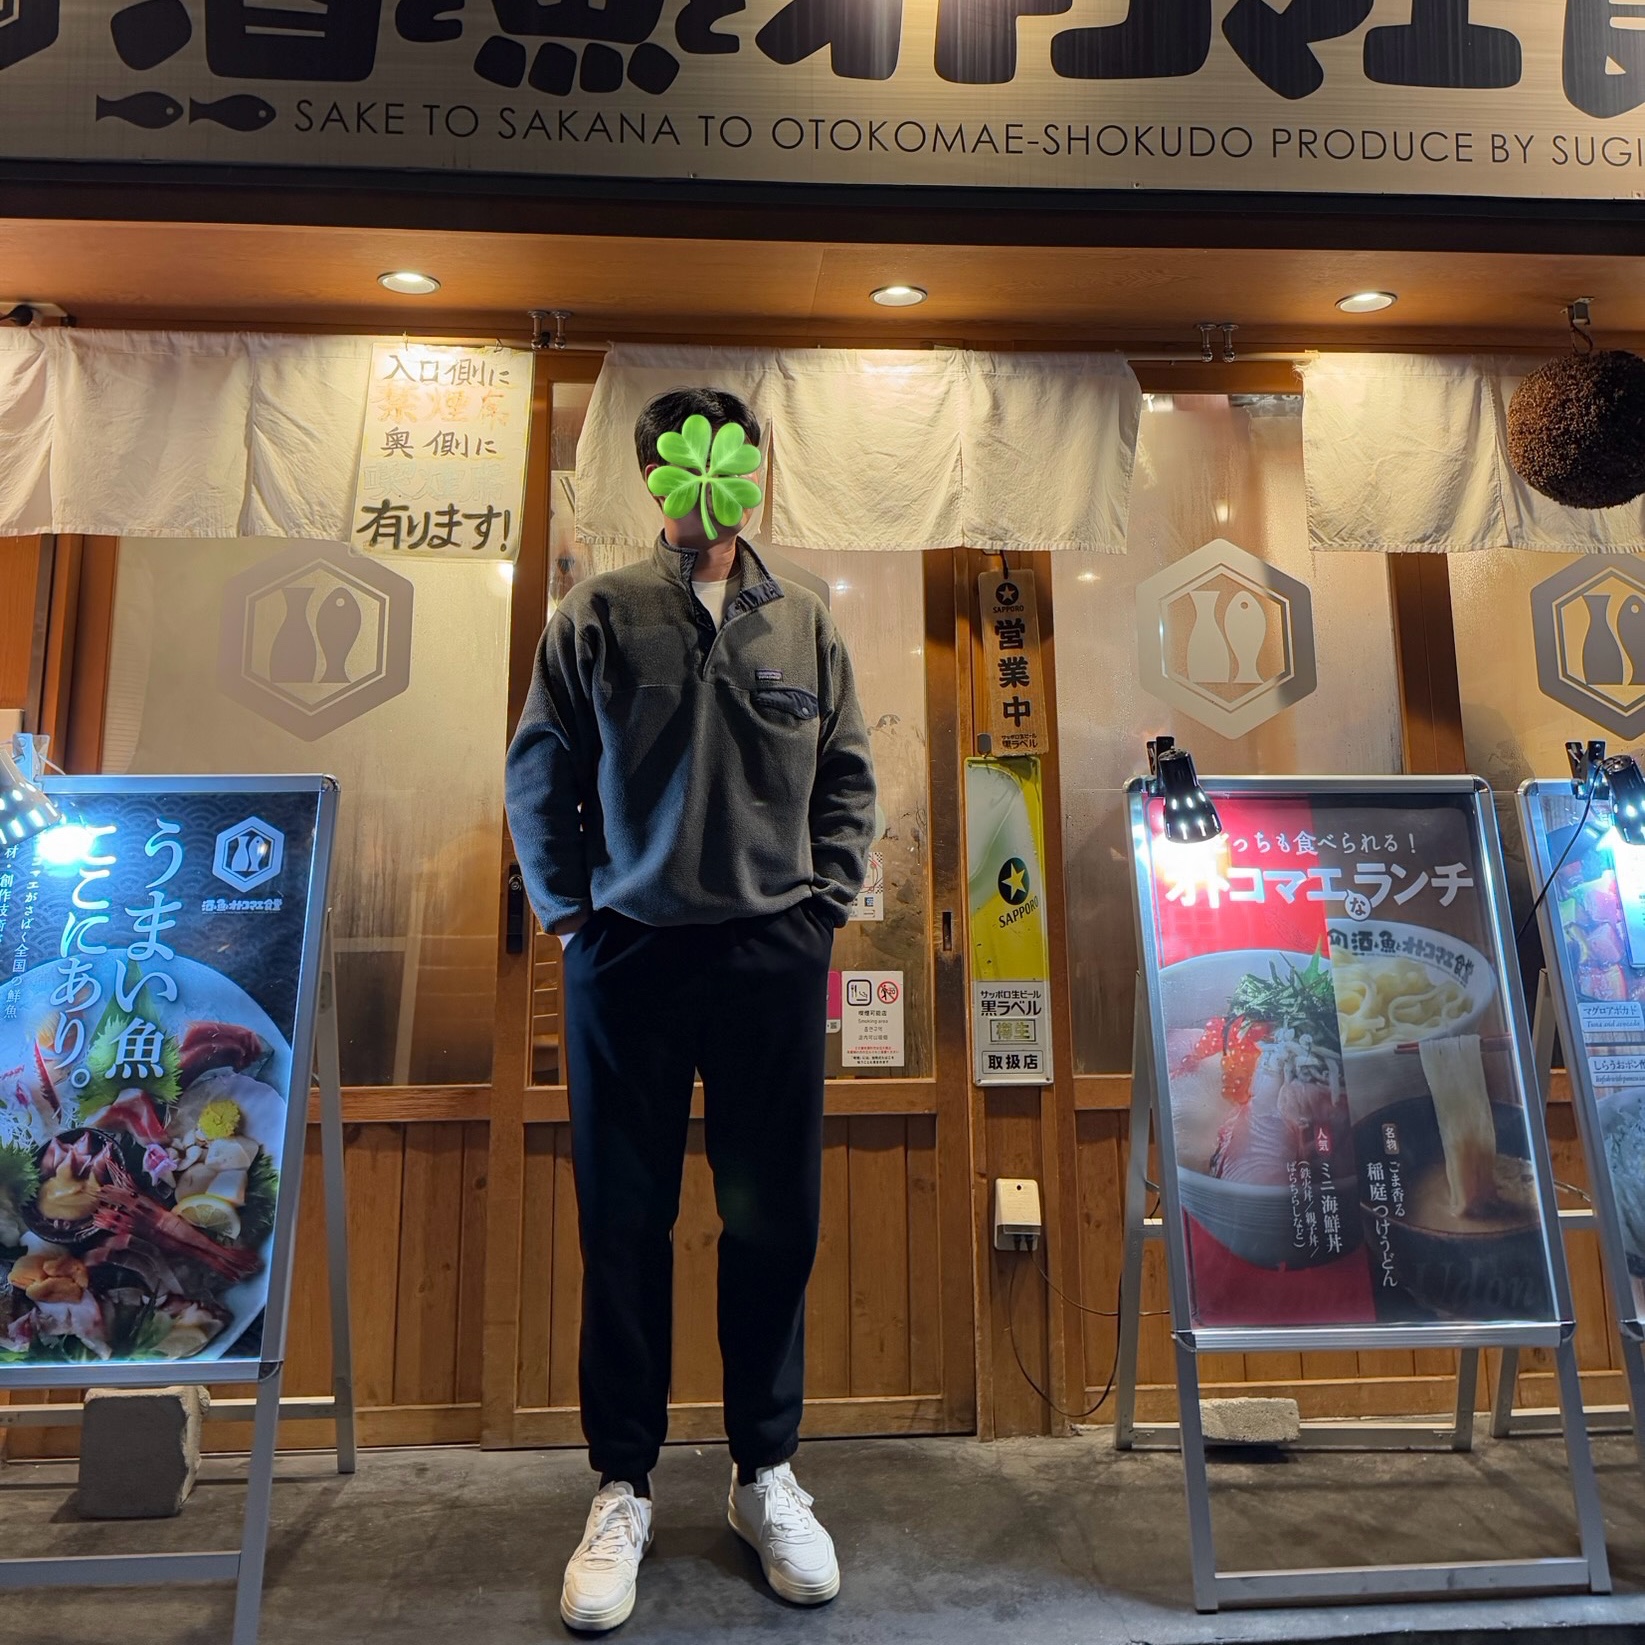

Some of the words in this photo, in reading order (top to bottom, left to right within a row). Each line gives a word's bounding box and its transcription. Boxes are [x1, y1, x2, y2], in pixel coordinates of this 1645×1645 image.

[295, 99, 405, 135] SAKE
[423, 104, 479, 138] TO
[498, 106, 681, 146] SAKANA
[697, 115, 753, 148] TO
[771, 117, 1253, 158] OTOKOMAE-SHOKUDO
[1272, 128, 1473, 163] PRODUCE
[1491, 133, 1535, 164] BY
[1551, 135, 1643, 167] SUGI
[383, 354, 510, 387] 入口側に
[380, 426, 498, 460] 奥側に
[355, 498, 511, 552] 有ります！
[993, 605, 1025, 614] SAPPORO
[995, 617, 1031, 728] 営業中
[998, 895, 1039, 929] SAPPORO
[50, 825, 117, 1089] ここにあり。
[104, 817, 183, 1079] うまい魚
[980, 990, 1042, 1000] サッポロ生ビール
[981, 999, 1042, 1017] 黒ラベル
[1583, 1005, 1638, 1016] マグロアボカド
[987, 1053, 1039, 1071] 取扱店
[1317, 1127, 1330, 1152] 人気
[1384, 1127, 1398, 1151] 名物
[1388, 1161, 1406, 1218] ごま香る
[1319, 1162, 1343, 1254] ミニ海鮮丼
[1366, 1161, 1398, 1288] 稲庭つけうどん
